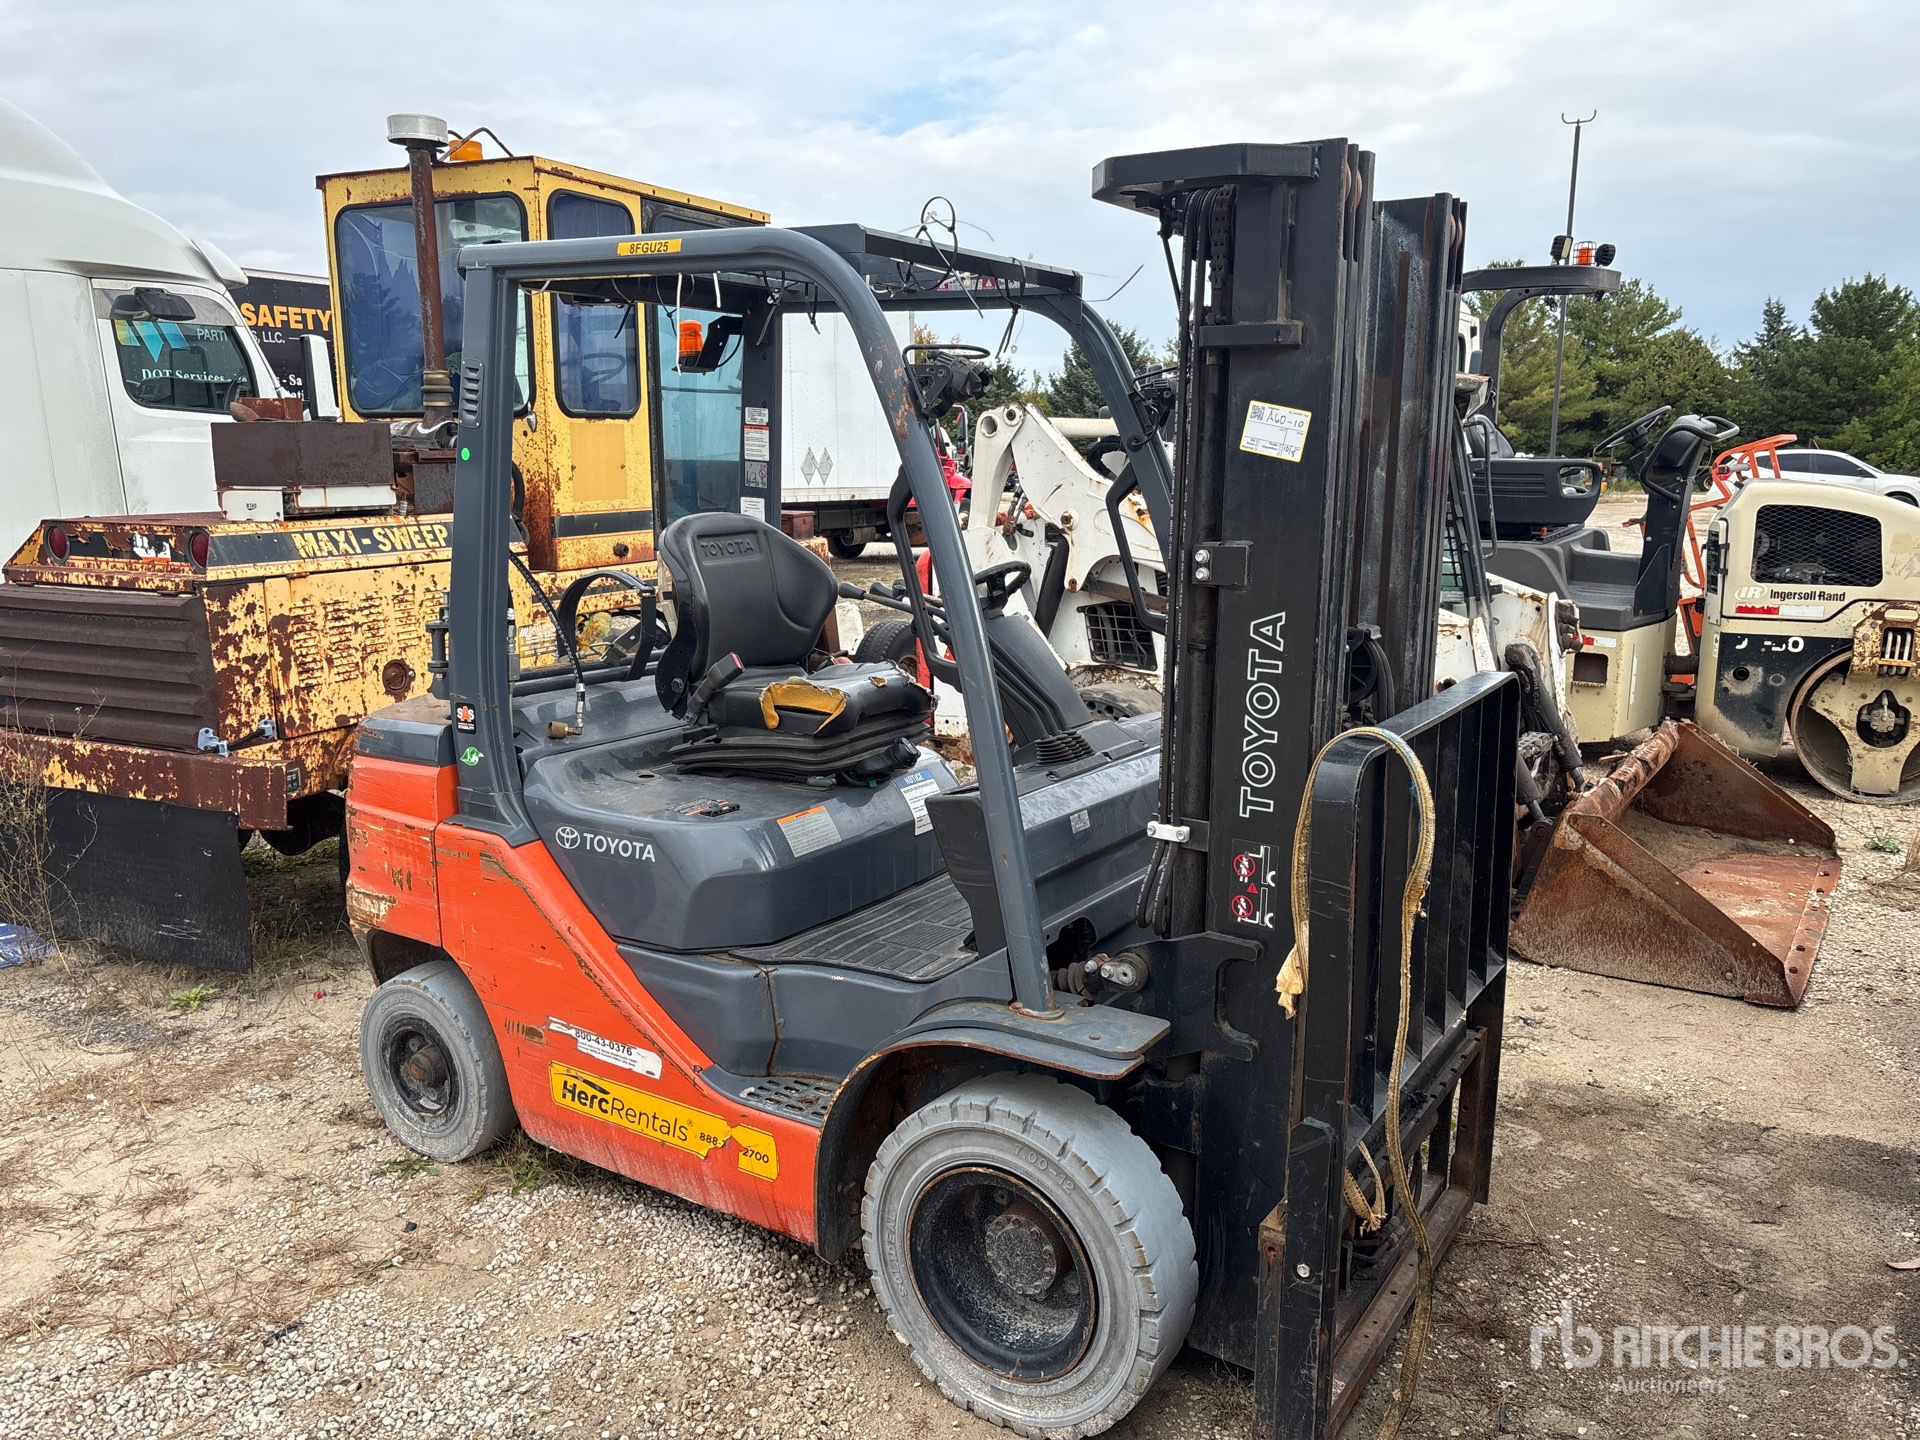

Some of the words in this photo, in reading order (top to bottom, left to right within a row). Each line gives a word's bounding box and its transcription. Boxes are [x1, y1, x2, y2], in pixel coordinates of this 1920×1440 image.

[629, 241, 669, 254] 8FGU25
[240, 303, 332, 332] SAFETY
[262, 331, 286, 344] LLC.
[701, 539, 755, 557] TOYOTA
[456, 706, 475, 722] SAS
[1239, 611, 1286, 818] TOYOTA
[904, 772, 925, 786] NOTICE
[583, 832, 656, 863] TOYOTA
[574, 1029, 633, 1057] 800-43-0376
[1013, 1143, 1076, 1196] 7.00-12
